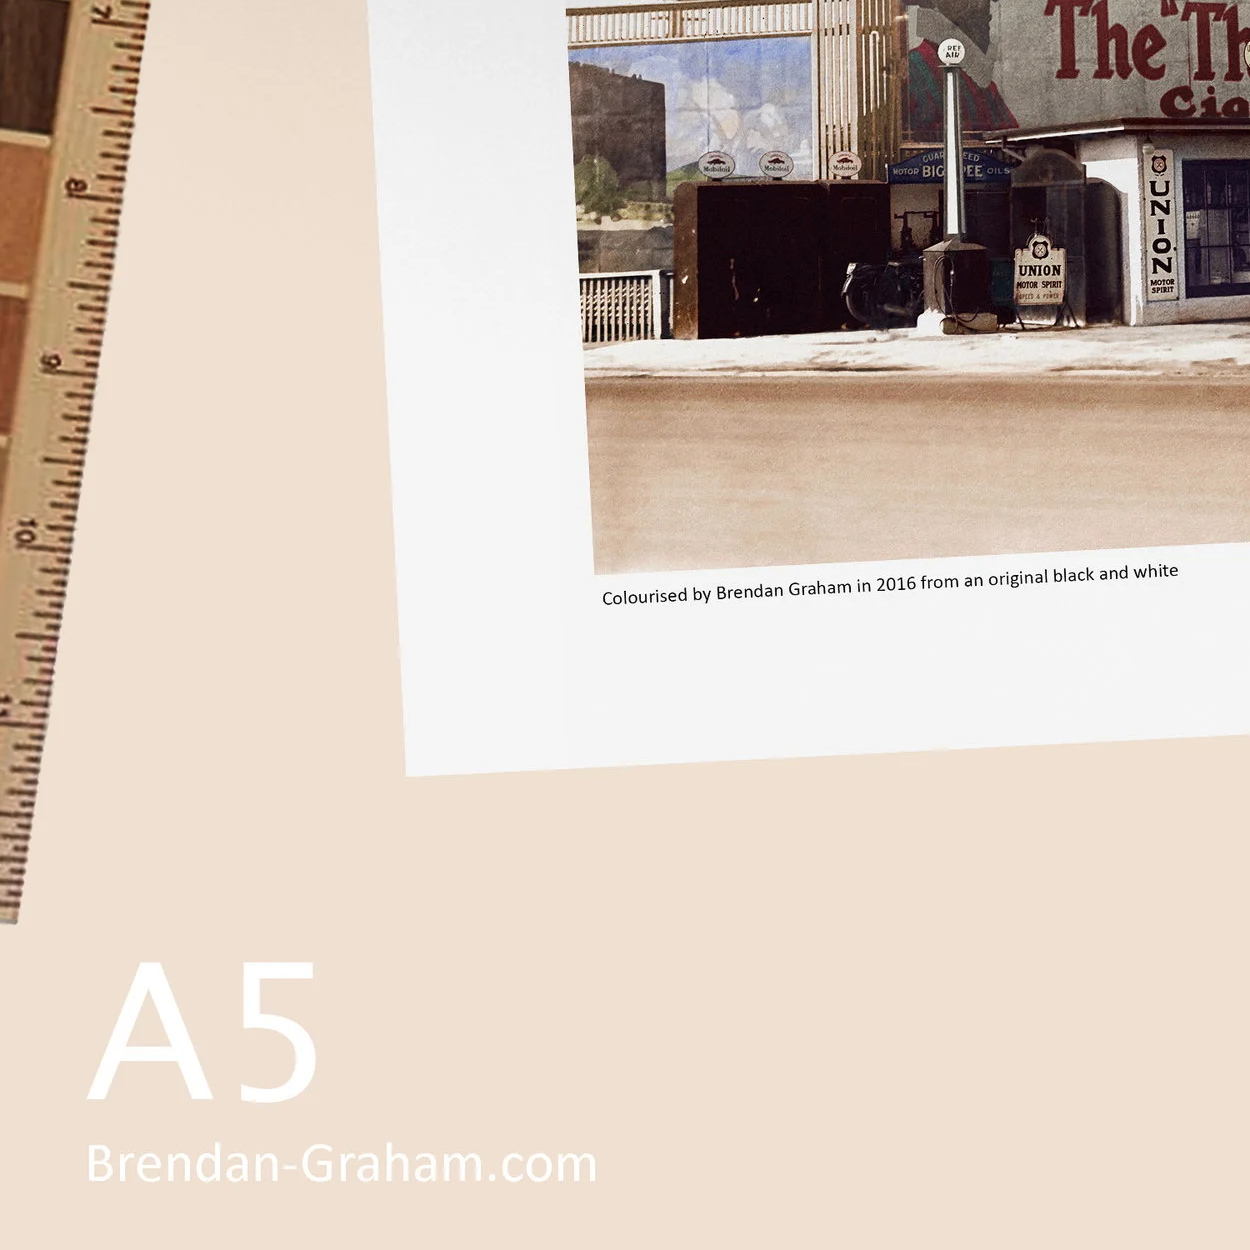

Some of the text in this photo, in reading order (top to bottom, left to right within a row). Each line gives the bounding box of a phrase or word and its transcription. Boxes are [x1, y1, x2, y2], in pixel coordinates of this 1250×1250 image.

[91, 4, 113, 20] 7
[703, 165, 731, 173] Mobiloil
[832, 163, 858, 171] Mobiloil
[892, 167, 920, 175] MOTOR
[986, 167, 1011, 175] OILS
[65, 177, 88, 193] 8
[1149, 180, 1173, 275] UNION
[1018, 264, 1062, 277] UNION
[1016, 280, 1063, 289] MOTOR SPIRIT
[1150, 278, 1175, 287] MOTOR
[1151, 286, 1174, 294] SPIRIT
[39, 353, 63, 370] 9
[15, 518, 38, 545] 10
[602, 563, 1179, 607] Colourised by Brendan Graham in 2016 from an original black and white
